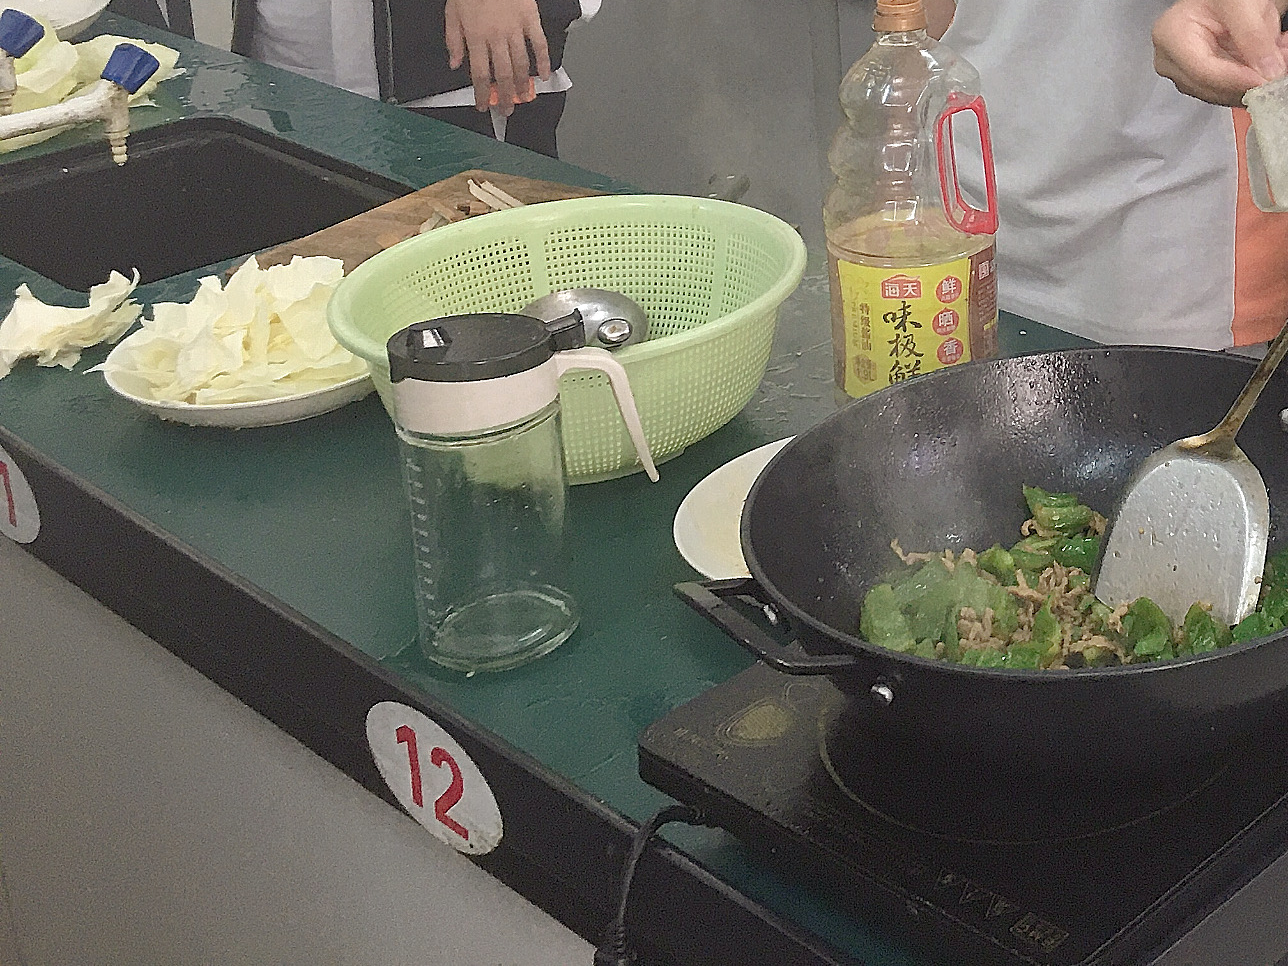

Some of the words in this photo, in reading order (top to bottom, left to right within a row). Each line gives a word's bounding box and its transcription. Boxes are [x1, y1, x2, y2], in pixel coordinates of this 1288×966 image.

[884, 282, 919, 298] 海天
[941, 277, 957, 296] 鲜
[938, 311, 954, 327] 晒
[943, 339, 959, 356] 香
[395, 724, 470, 841] 12
